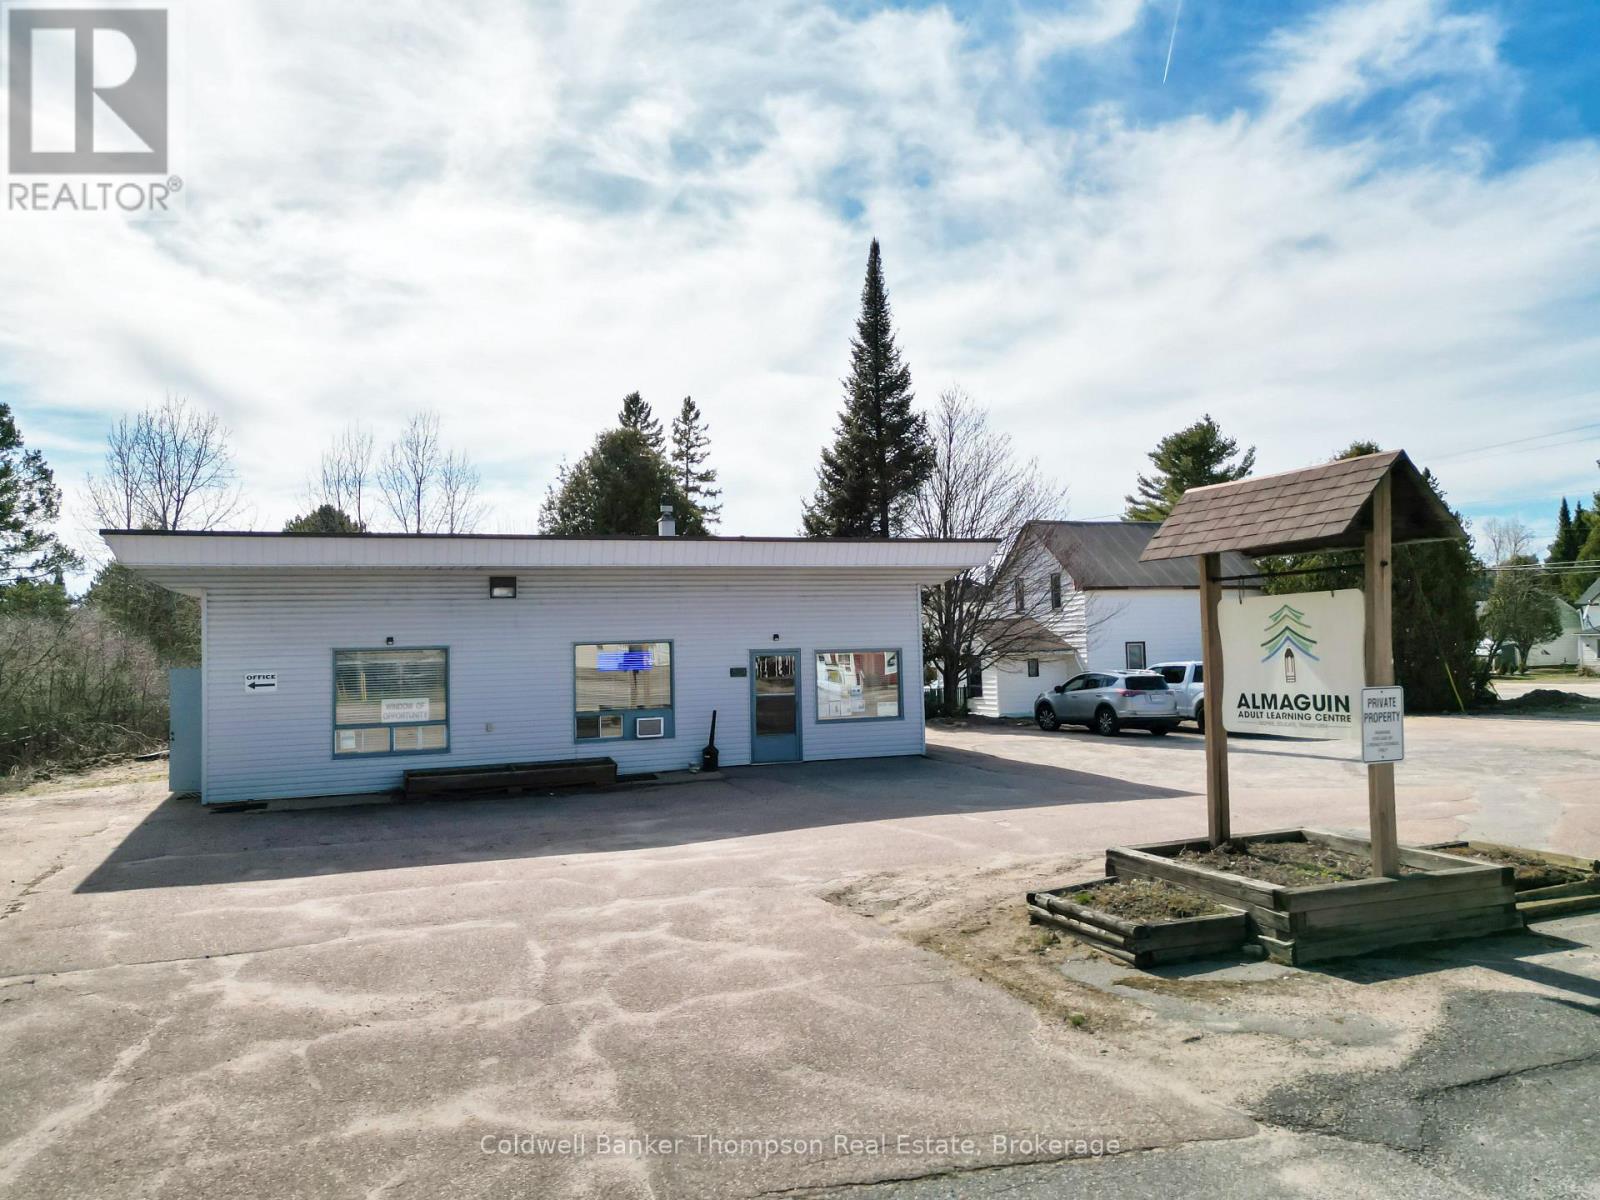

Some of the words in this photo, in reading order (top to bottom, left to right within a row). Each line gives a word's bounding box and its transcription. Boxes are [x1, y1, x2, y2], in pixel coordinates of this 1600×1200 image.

[1237, 693, 1350, 713] ALMAGUIN
[1367, 697, 1397, 709] PRIVATE
[1238, 711, 1263, 719] ADULT
[1266, 712, 1312, 721] LEARNING
[1314, 713, 1351, 723] CENTRE
[1364, 711, 1400, 723] PROPERTY
